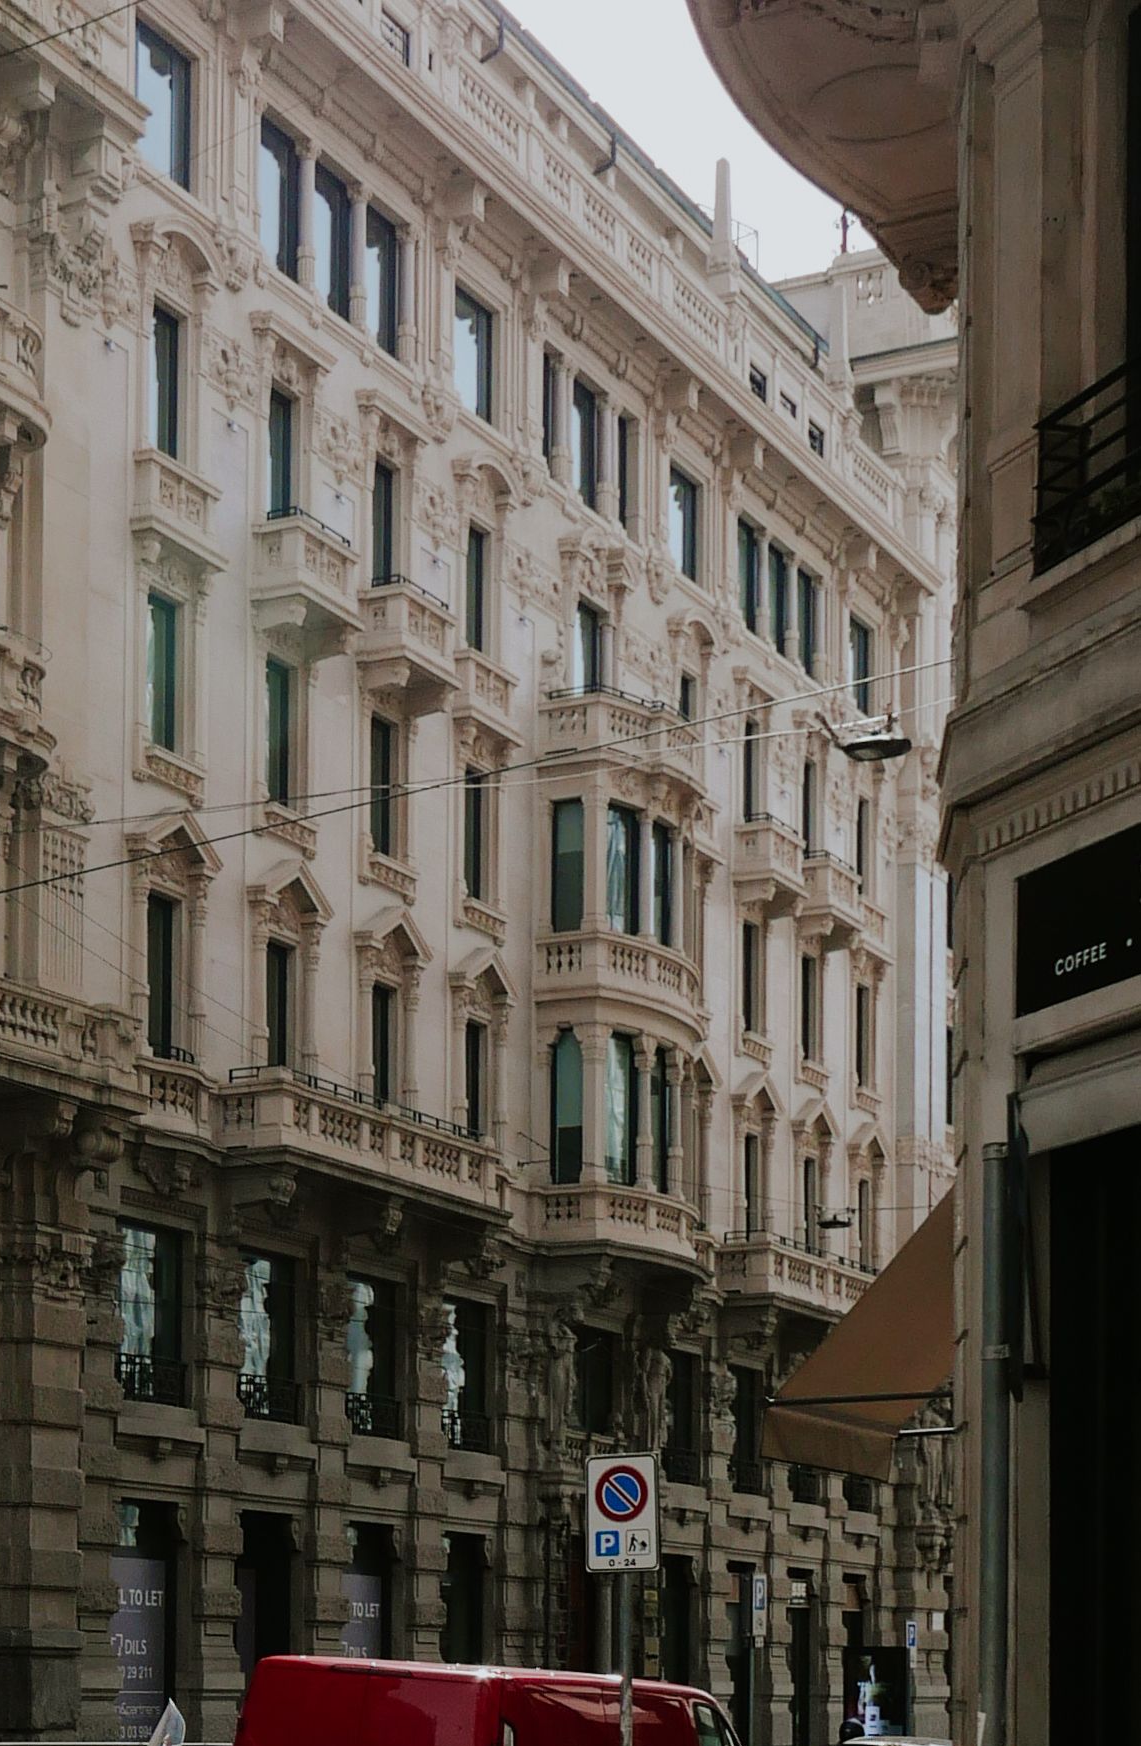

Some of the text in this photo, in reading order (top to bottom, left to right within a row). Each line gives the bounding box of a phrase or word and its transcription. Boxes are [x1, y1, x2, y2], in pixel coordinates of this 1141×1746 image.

[1054, 941, 1108, 976] COFFEE
[600, 1534, 615, 1554] P
[624, 1558, 636, 1567] 24
[129, 1589, 143, 1606] TO
[145, 1590, 163, 1607] LET
[756, 1581, 764, 1607] P
[352, 1602, 380, 1618] TO LET
[125, 1639, 147, 1655] DILS
